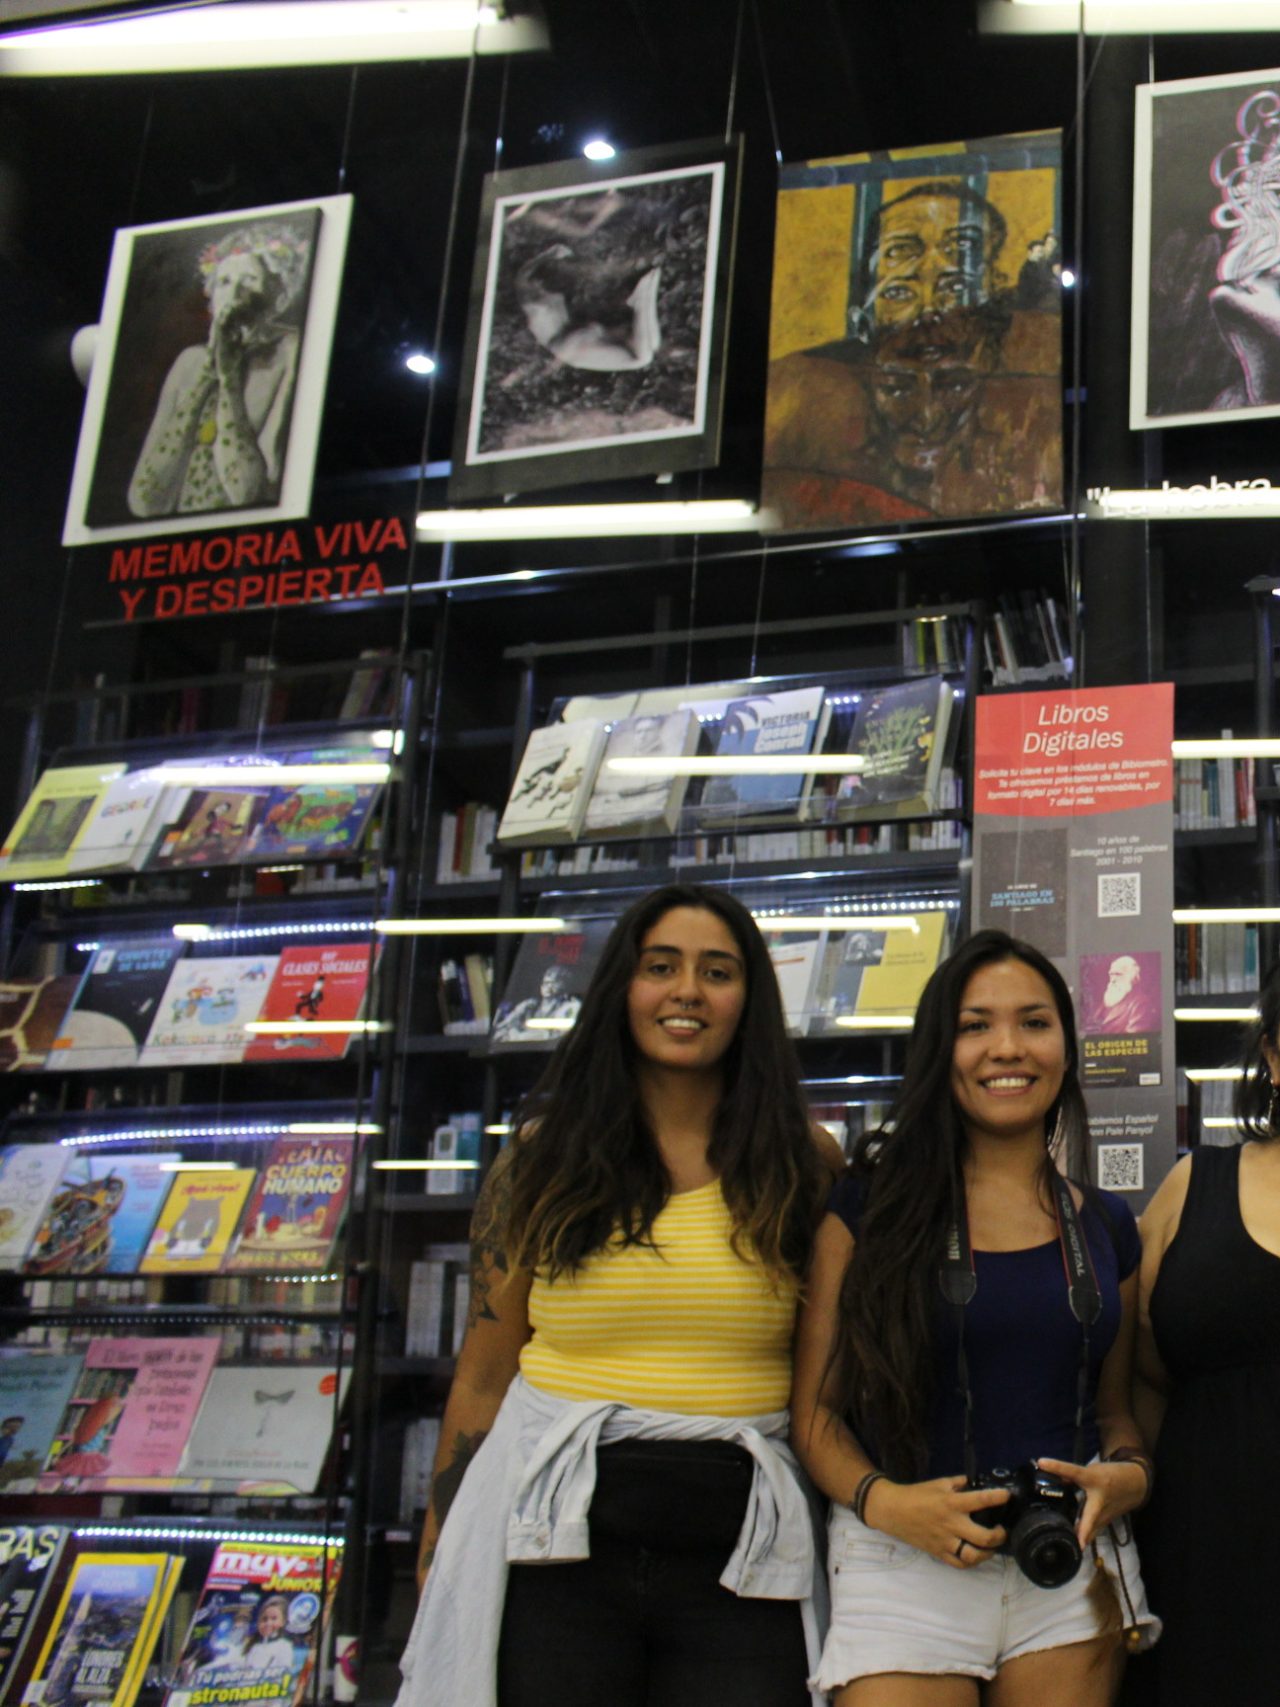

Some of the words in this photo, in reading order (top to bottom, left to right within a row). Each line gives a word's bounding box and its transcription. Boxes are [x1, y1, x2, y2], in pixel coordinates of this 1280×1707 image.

[108, 529, 302, 583] MEMORIA
[314, 516, 408, 558] VIVA
[118, 587, 146, 623] Y
[154, 561, 385, 620] DESPIERTA
[761, 710, 811, 727] VICTORIA
[1038, 703, 1110, 727] Libros
[1023, 729, 1124, 757] Digitales
[1085, 1042, 1096, 1050] EL
[1098, 1041, 1134, 1049] ORIGEN
[1135, 1039, 1148, 1047] DE
[1085, 1049, 1102, 1057] LAS
[1104, 1048, 1148, 1056] ESPECIES
[1087, 1116, 1124, 1126] ablemos
[266, 1164, 347, 1182] CUERPO
[262, 1177, 342, 1196] HUMANO
[1067, 1223, 1086, 1278] DIGITAL
[213, 1551, 297, 1578] muy
[190, 1673, 293, 1706] stronauta!
